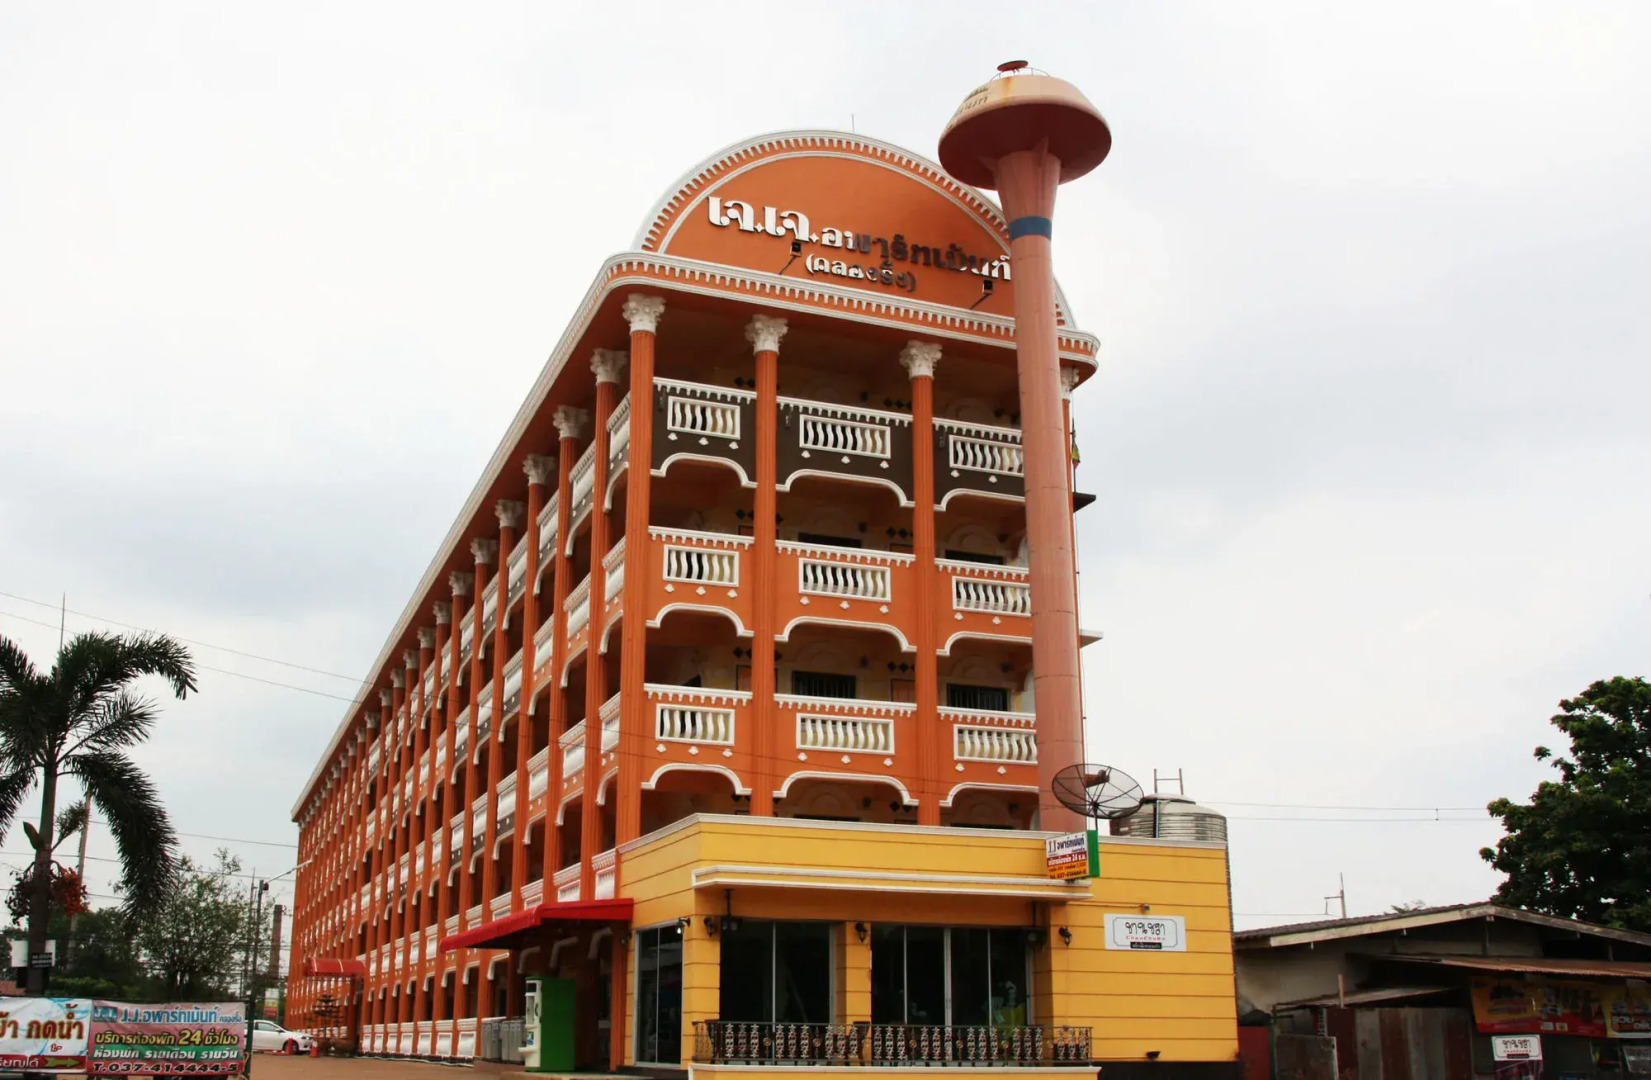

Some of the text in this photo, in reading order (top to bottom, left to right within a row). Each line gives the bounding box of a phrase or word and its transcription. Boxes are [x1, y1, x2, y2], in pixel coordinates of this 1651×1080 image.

[26, 1003, 84, 1039] กดน้ำ
[95, 1028, 238, 1045] บริการห้องพัก 24 ชั่วโมง
[200, 1047, 238, 1059] รายวัน
